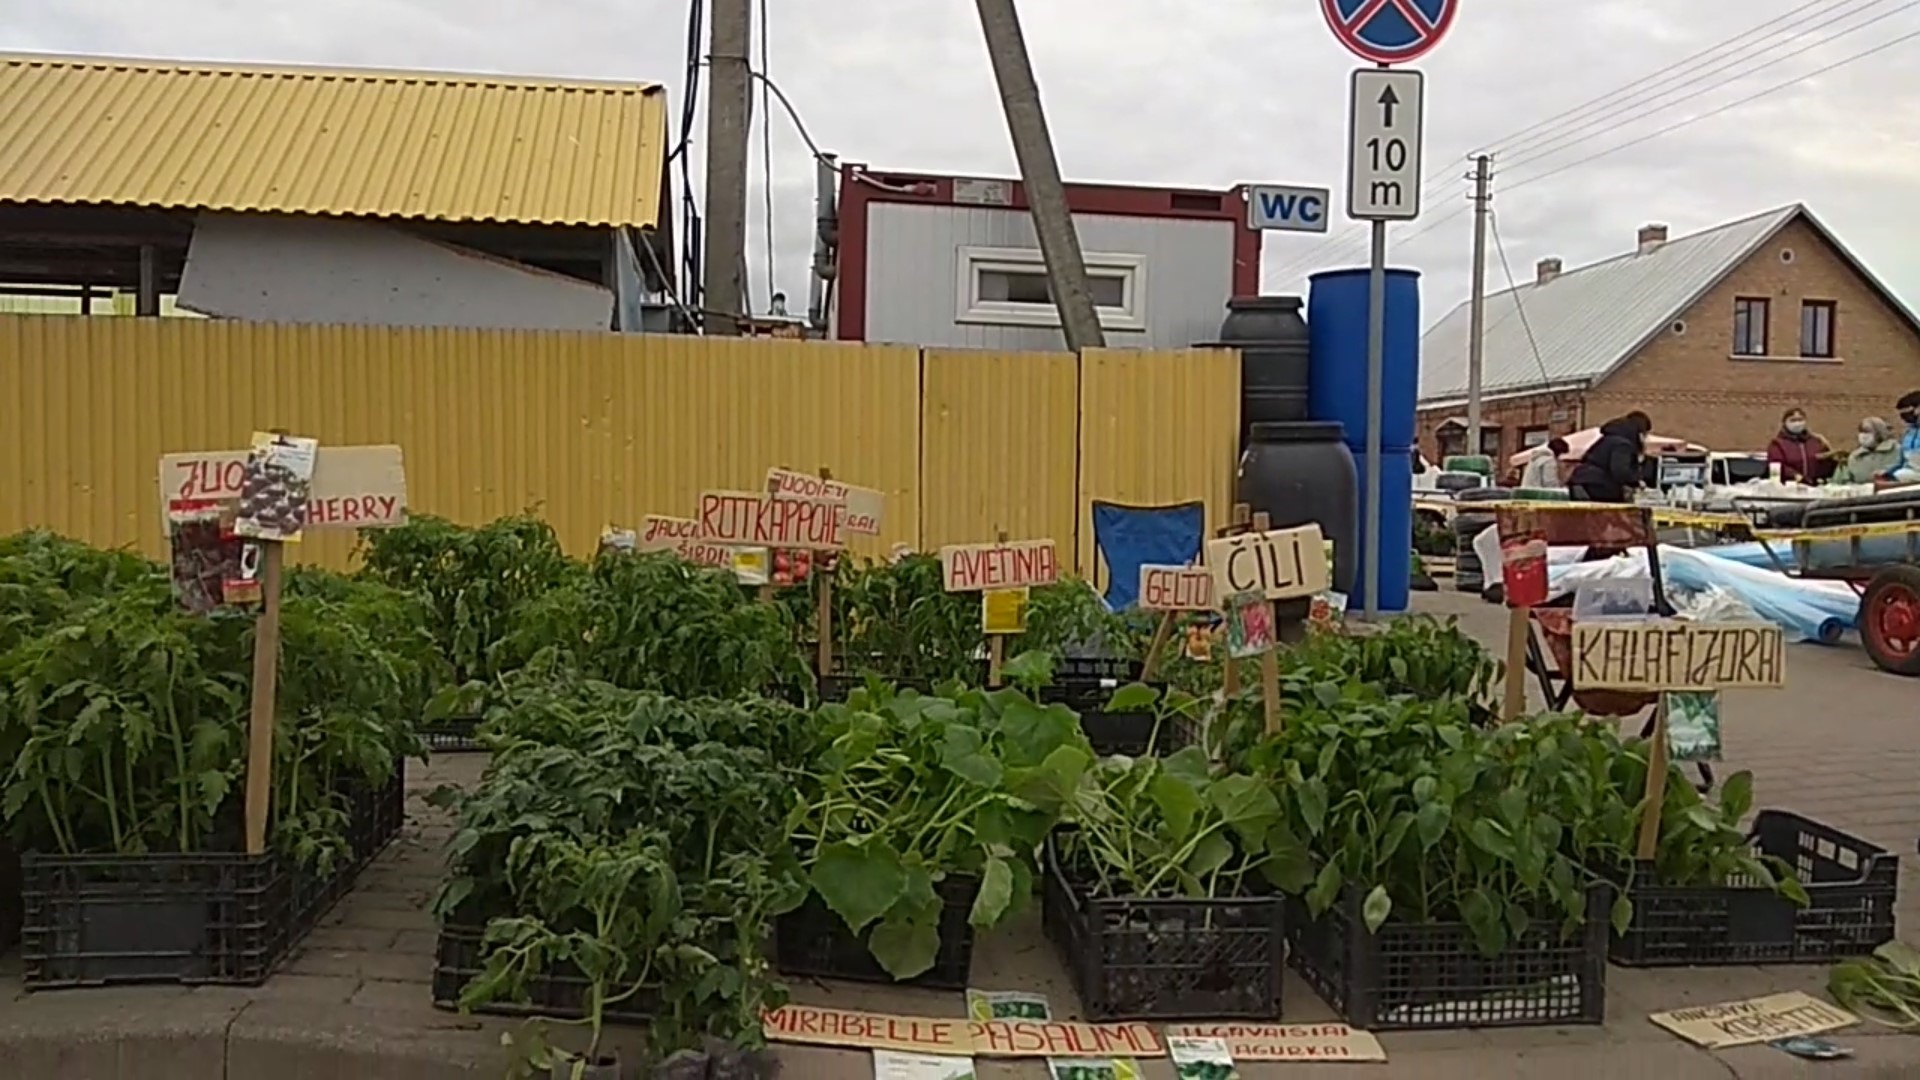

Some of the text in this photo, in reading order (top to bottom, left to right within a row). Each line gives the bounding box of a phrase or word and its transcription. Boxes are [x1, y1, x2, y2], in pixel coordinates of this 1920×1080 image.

[1366, 137, 1407, 172] 10
[1260, 192, 1322, 222] WC
[1370, 181, 1402, 206] m
[305, 495, 397, 524] HERRY
[1146, 569, 1213, 607] GELTO
[762, 1008, 954, 1046] MIRABELLE
